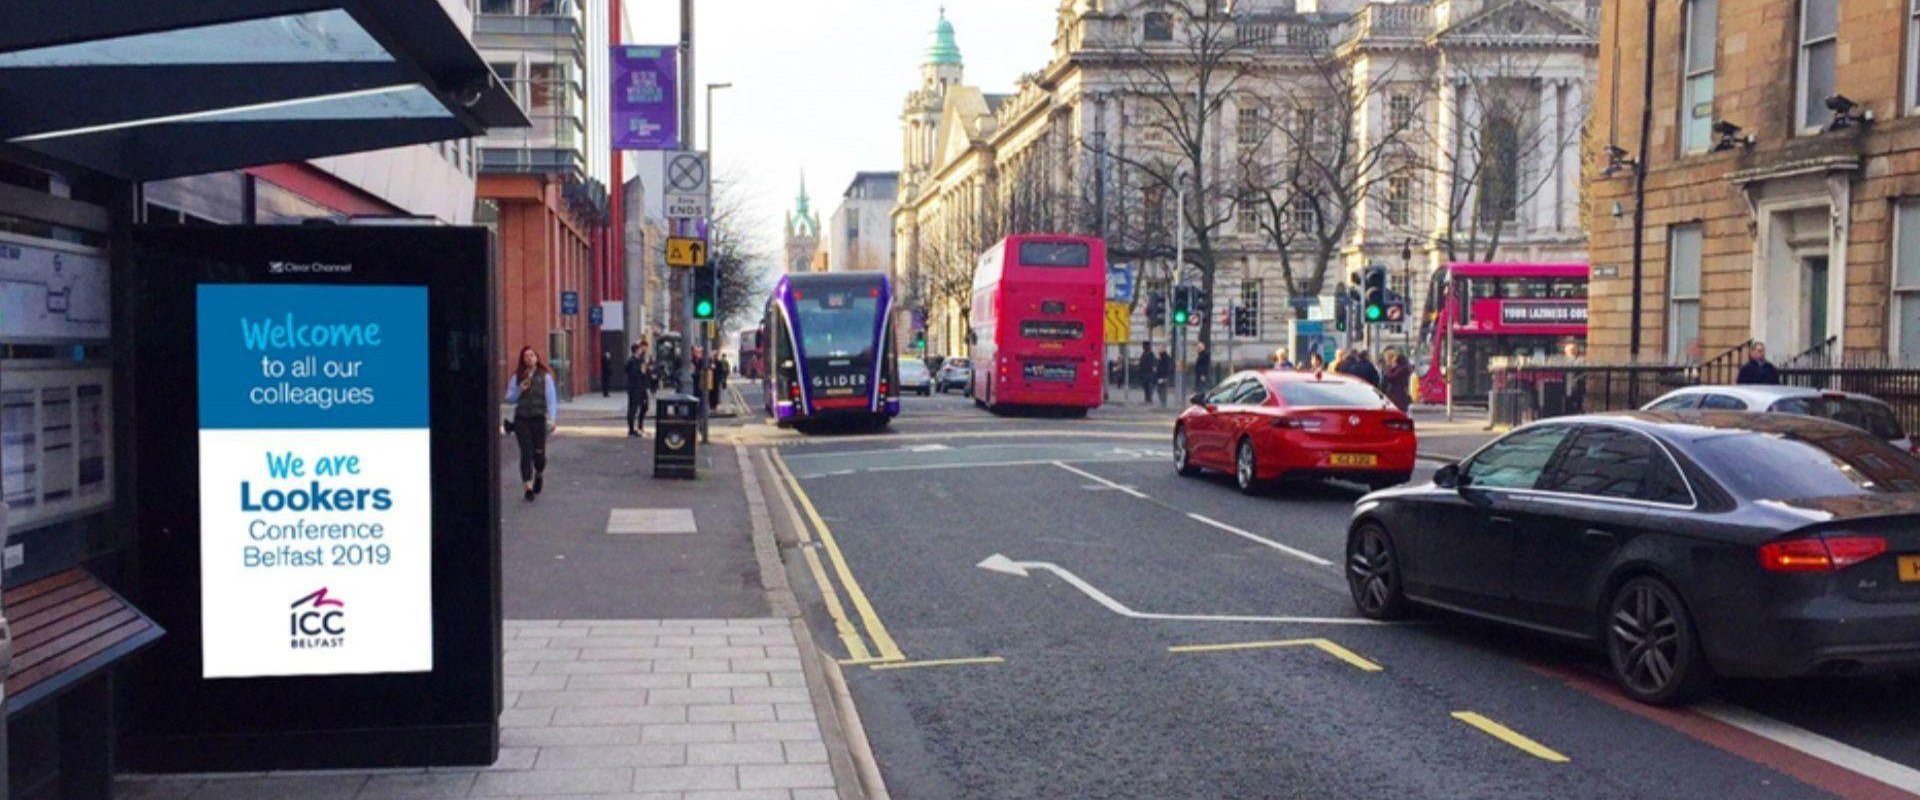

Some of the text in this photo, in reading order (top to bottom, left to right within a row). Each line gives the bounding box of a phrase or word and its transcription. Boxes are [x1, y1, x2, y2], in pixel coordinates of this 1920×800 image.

[669, 205, 703, 215] ENDS
[285, 261, 352, 273] Clear Channel
[1504, 308, 1527, 319] YOUR
[1529, 308, 1568, 319] LAZINESS
[241, 312, 382, 350] Welcome
[261, 355, 362, 378] to all our
[812, 374, 866, 387] GLIDER
[250, 382, 375, 409] colleagues
[266, 451, 360, 479] We are
[240, 480, 393, 511] Lookers
[249, 518, 384, 540] Conference
[243, 543, 391, 567] Belfast 2019
[291, 610, 345, 636] ICC
[290, 637, 344, 648] BELFAST
